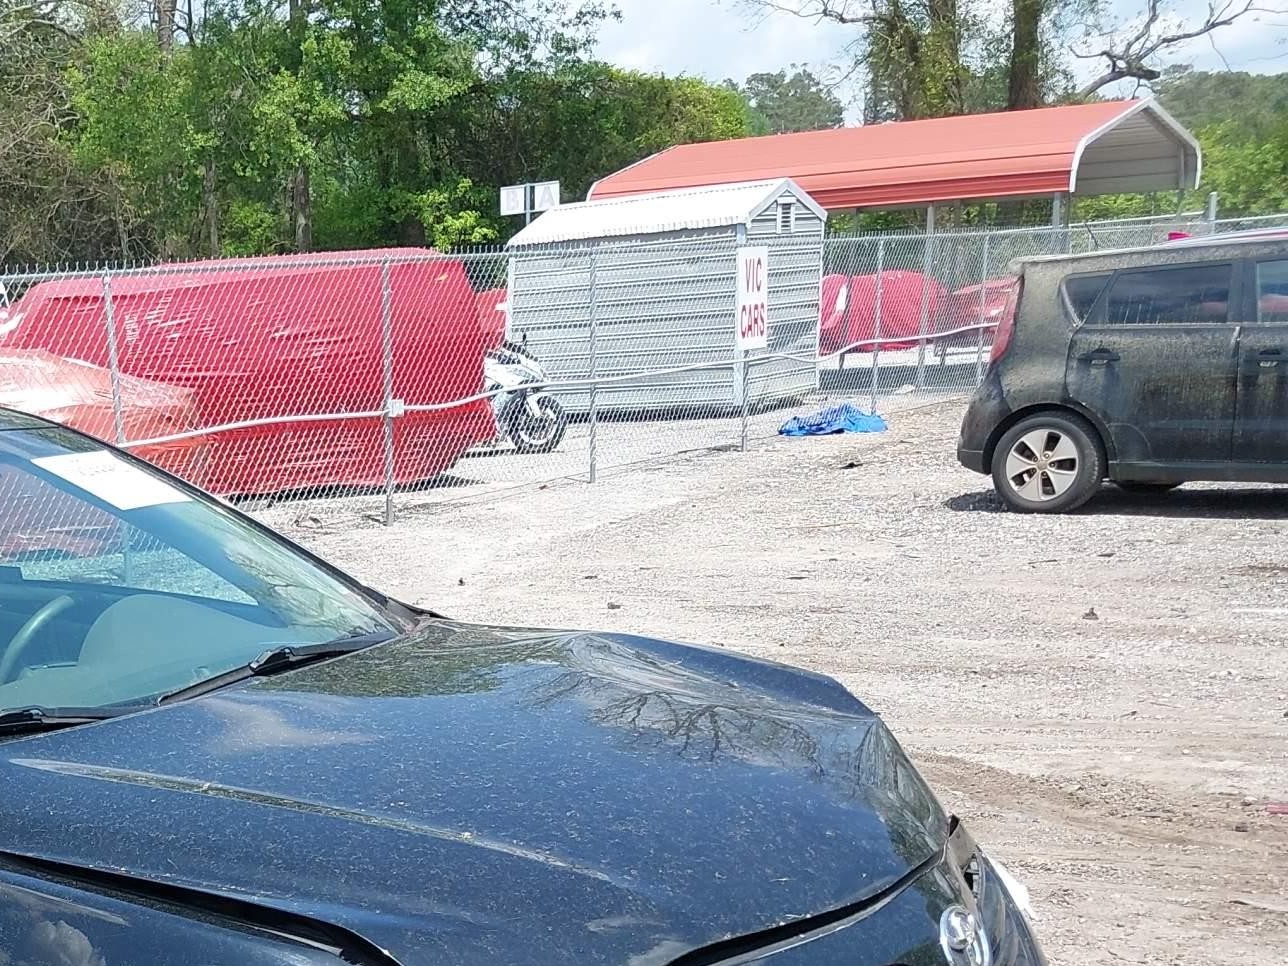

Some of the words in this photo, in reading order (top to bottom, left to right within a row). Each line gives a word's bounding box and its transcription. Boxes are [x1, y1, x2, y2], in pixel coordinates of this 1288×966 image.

[505, 190, 519, 211] B
[538, 185, 555, 209] A
[745, 257, 762, 293] VIC
[740, 302, 765, 339] CARS
